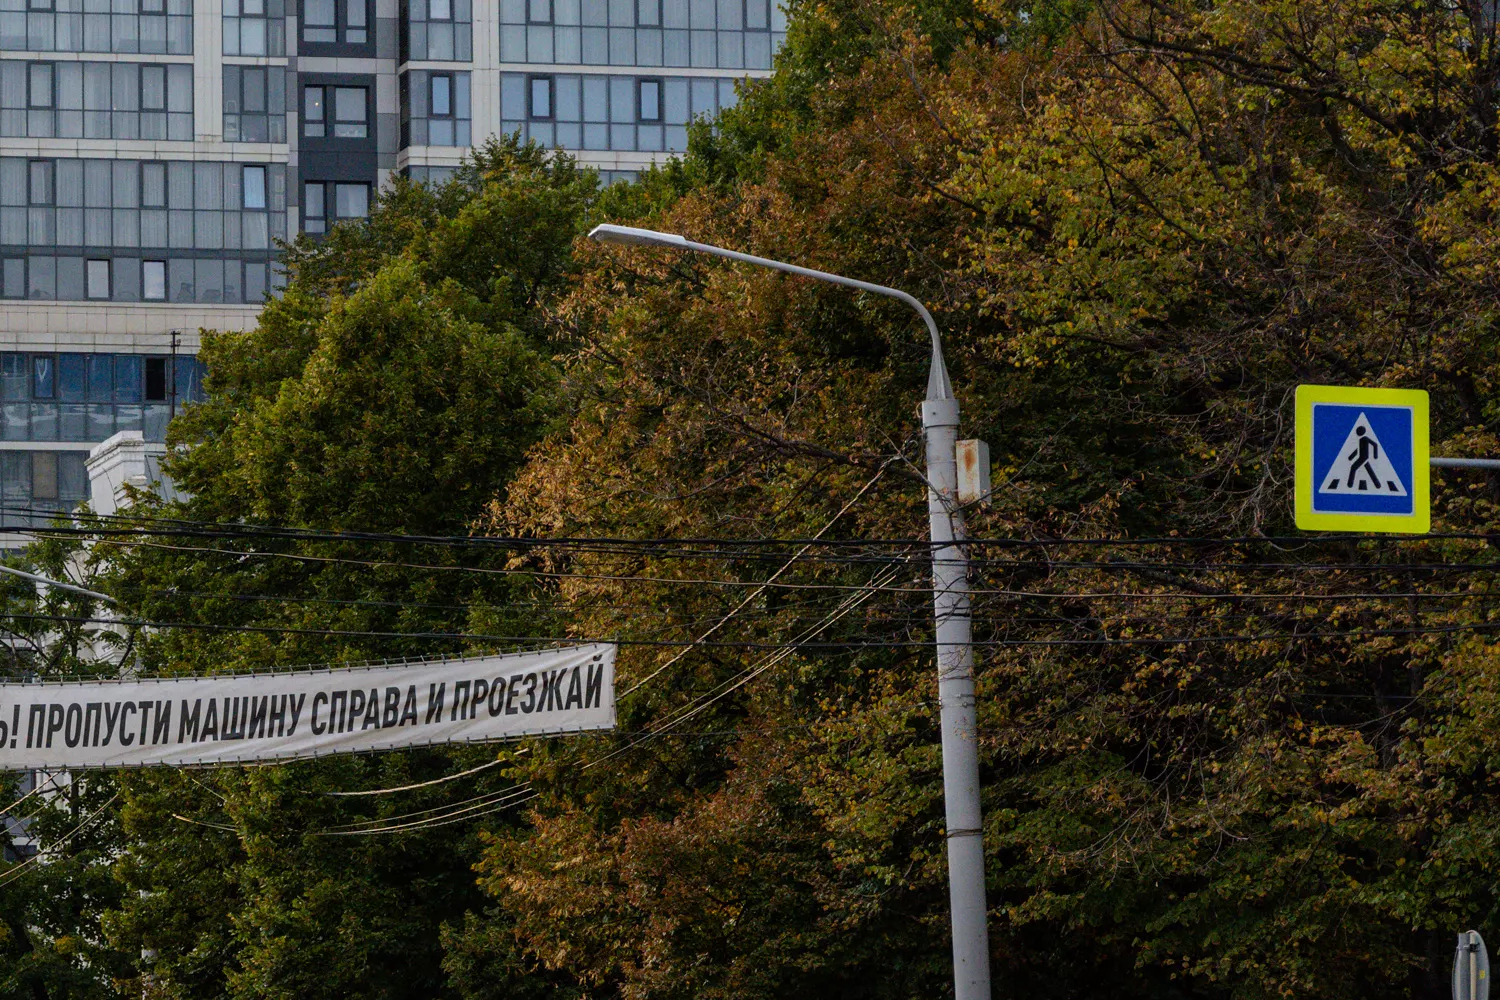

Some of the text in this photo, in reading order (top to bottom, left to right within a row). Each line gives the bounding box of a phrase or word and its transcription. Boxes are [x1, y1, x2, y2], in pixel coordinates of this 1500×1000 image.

[26, 700, 172, 749] ПРОПУСТИ
[178, 693, 306, 744] МАШИНУ
[311, 684, 418, 736] СПРАВА
[425, 683, 446, 724] И
[451, 654, 604, 722] ПРОЕЗЖАЙ
